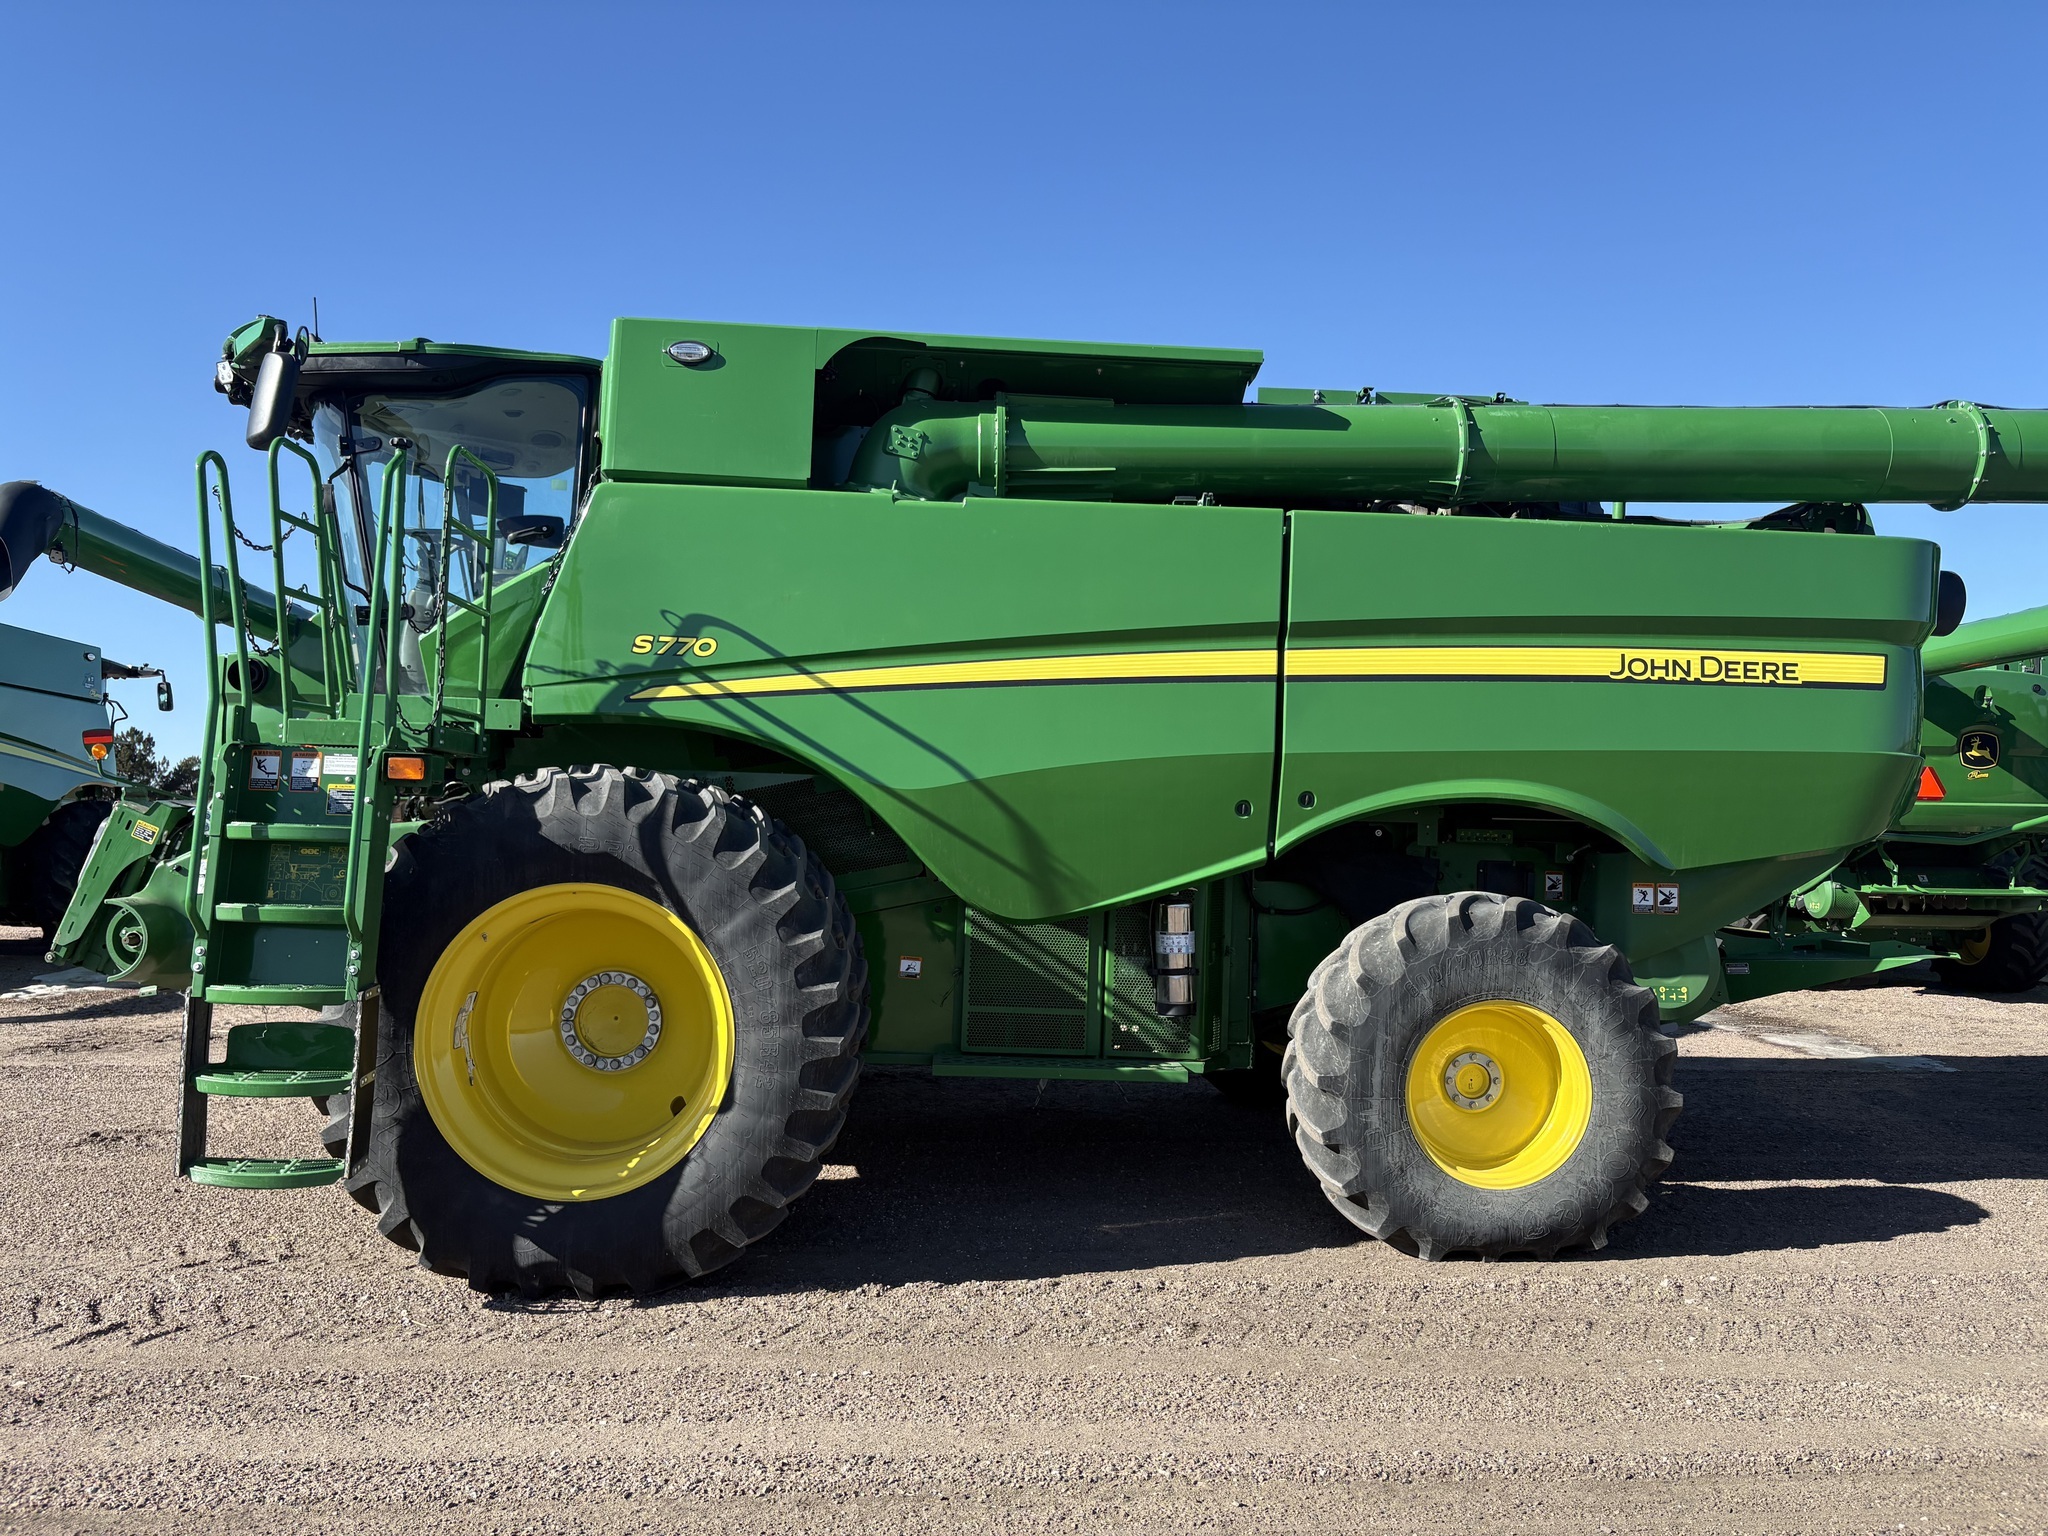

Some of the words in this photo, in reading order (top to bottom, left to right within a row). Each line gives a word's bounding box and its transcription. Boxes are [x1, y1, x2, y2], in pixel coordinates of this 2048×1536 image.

[631, 634, 718, 657] S770
[1610, 653, 1691, 680] JOHN
[1699, 656, 1801, 684] DEERE
[743, 946, 781, 1091] 520/85R42
